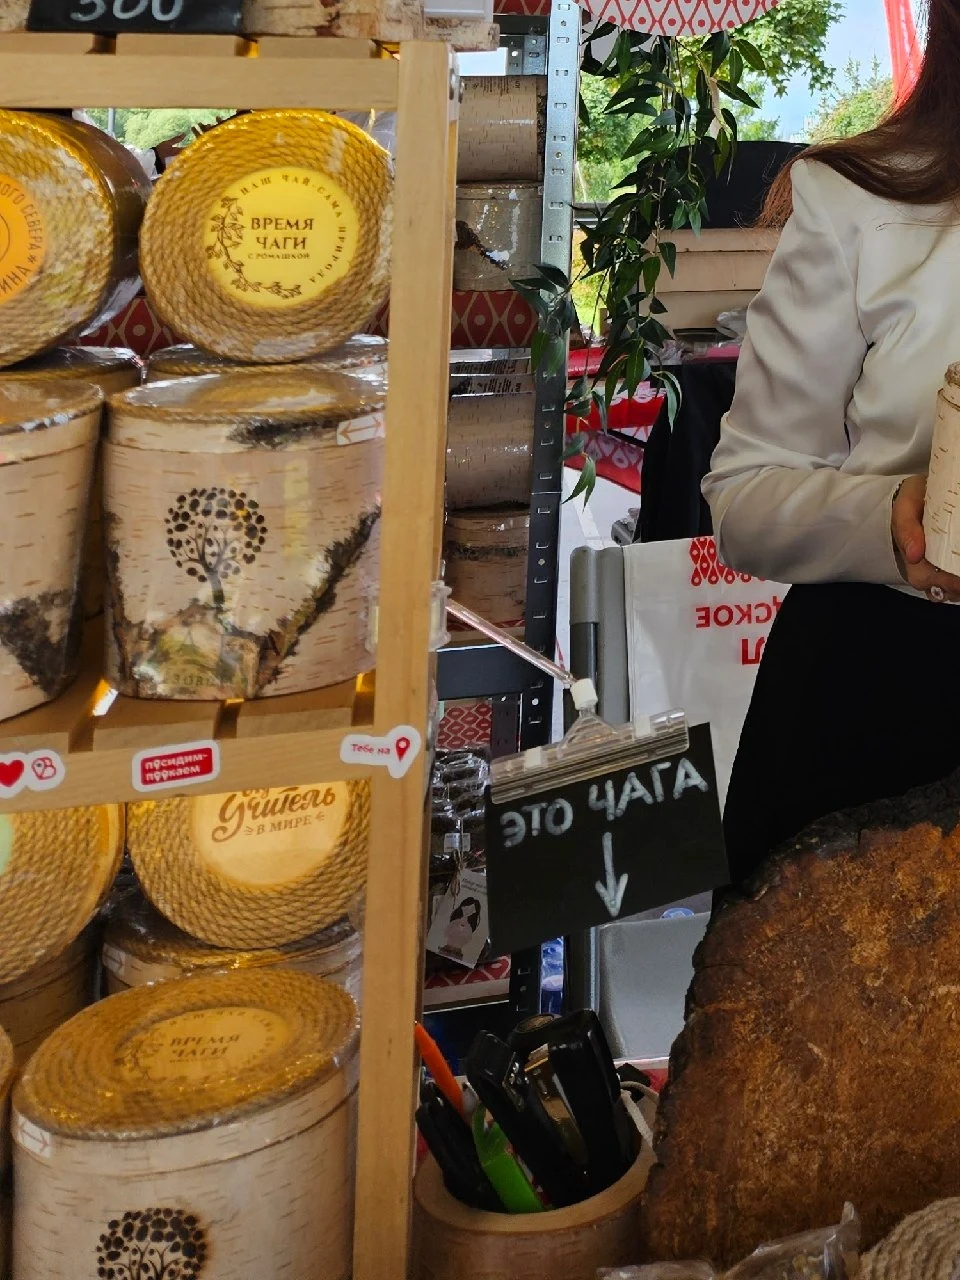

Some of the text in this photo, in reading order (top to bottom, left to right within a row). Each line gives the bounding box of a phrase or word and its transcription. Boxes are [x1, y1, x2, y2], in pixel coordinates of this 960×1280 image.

[251, 217, 314, 231] ВРЕМЯ
[255, 236, 308, 250] ЧАГИ
[255, 252, 311, 261] РОМАШКОЙ
[500, 756, 710, 848] ЭТО ЧАГА
[211, 786, 336, 843] Учитель
[256, 814, 312, 836] В МИРЕ
[171, 1046, 229, 1059] ЧАГИ
